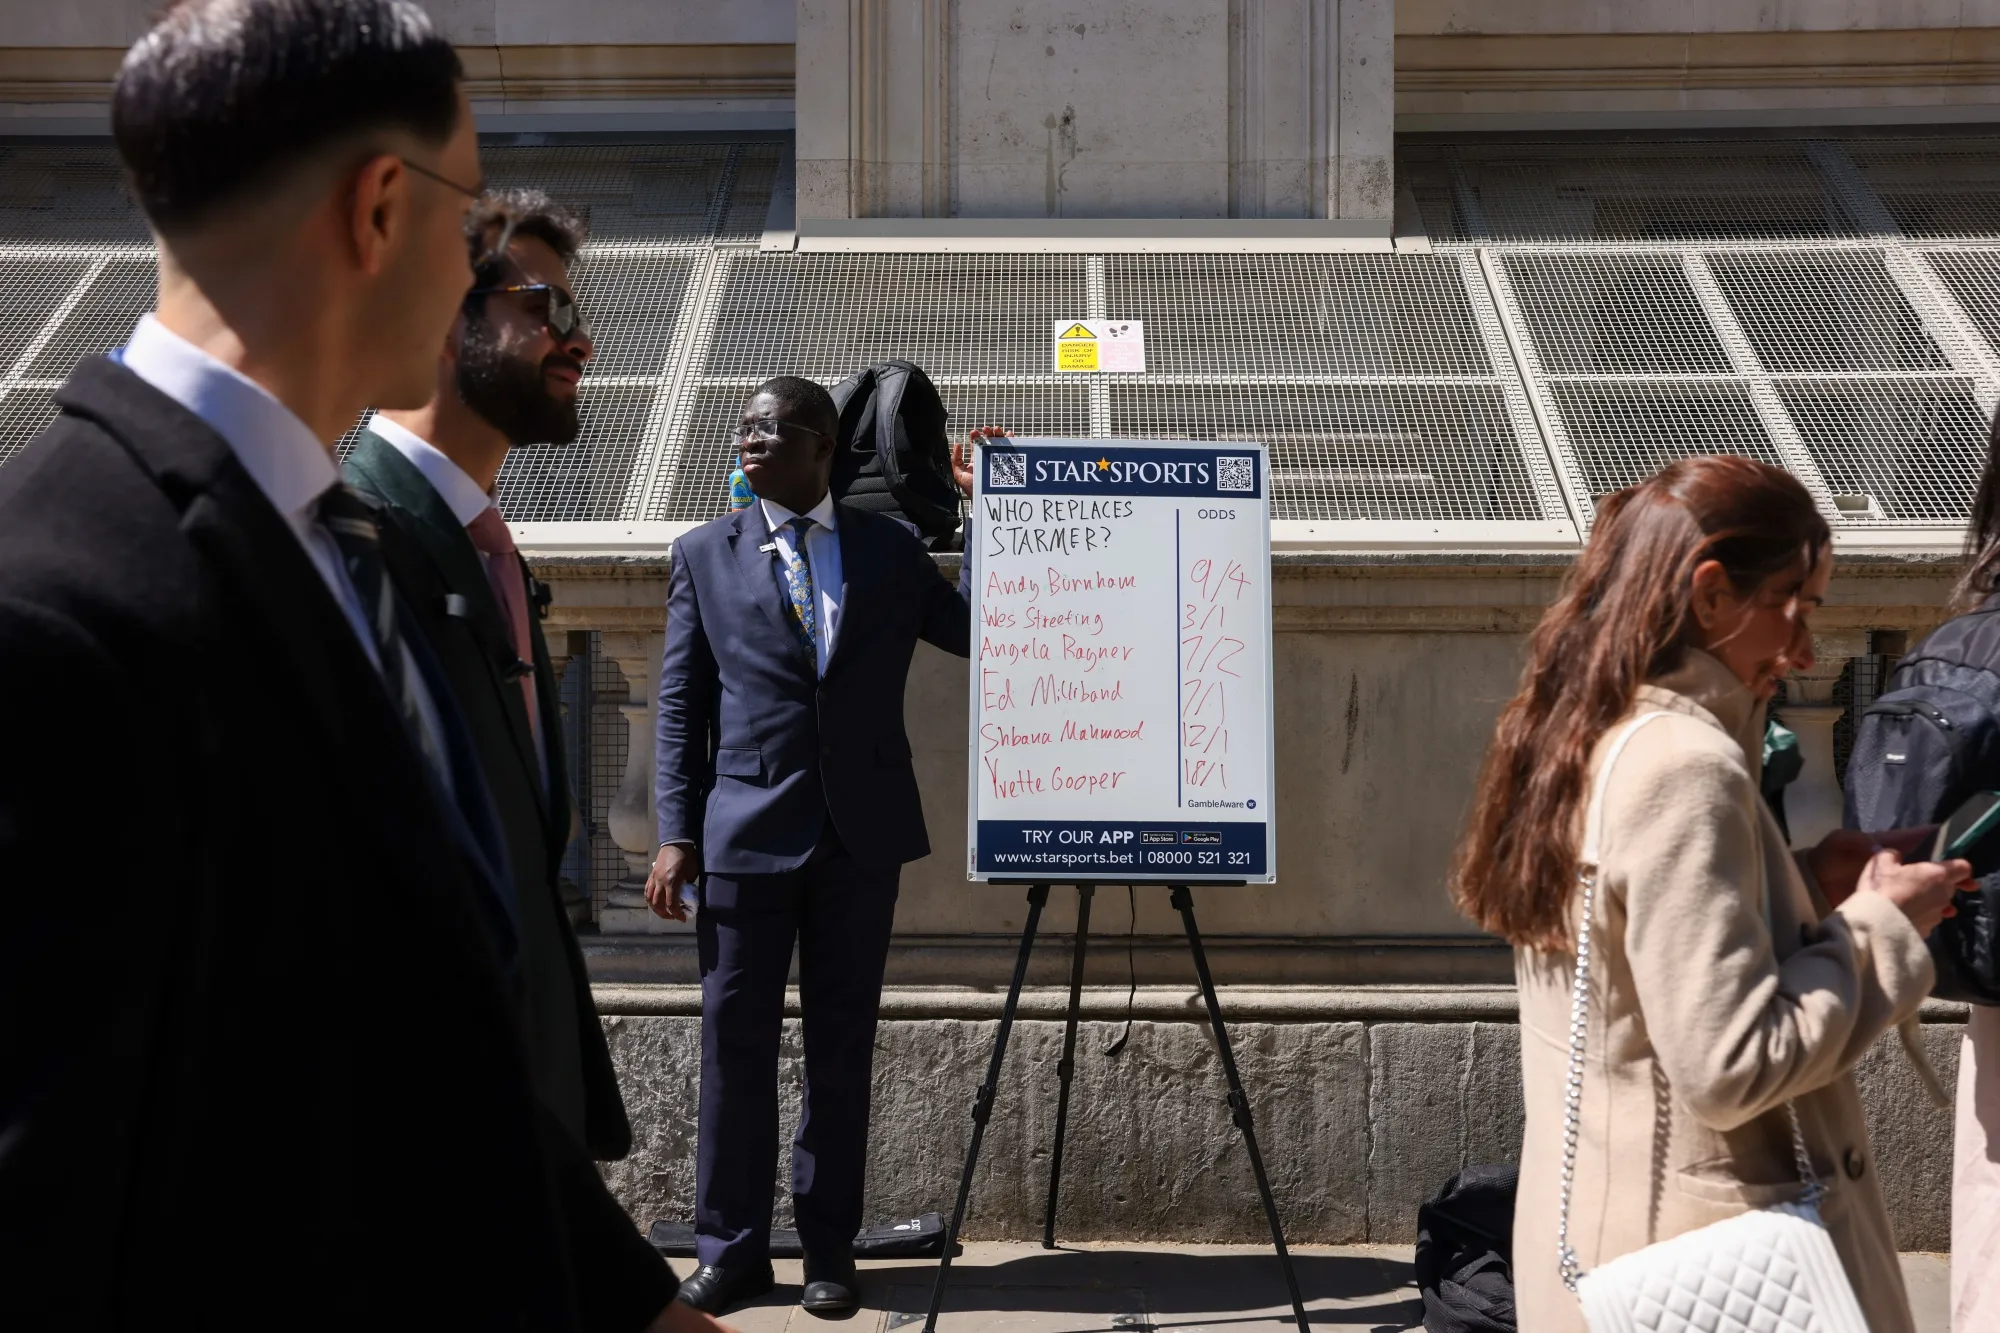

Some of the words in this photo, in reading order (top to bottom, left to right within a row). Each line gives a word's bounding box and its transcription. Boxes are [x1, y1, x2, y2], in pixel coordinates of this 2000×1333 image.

[1035, 459, 1102, 483] STAR
[1110, 461, 1210, 484] SPORTS
[985, 497, 1033, 522] WHO
[1043, 499, 1133, 522] REPLACES
[1198, 509, 1236, 520] ODDS
[989, 526, 1112, 557] STARMER?
[987, 571, 1040, 602] Andy
[1047, 566, 1136, 597] Burnham
[1191, 559, 1251, 602] 9/4
[980, 604, 1016, 628] Wes
[1023, 606, 1104, 635] Streeting
[1182, 604, 1225, 630] 3/1
[980, 636, 1051, 665] Angela
[1182, 635, 1245, 678] 7/2
[983, 668, 1015, 712] Ed
[1182, 679, 1225, 725] 7/1
[1060, 719, 1144, 742] Mahmood
[1182, 721, 1228, 753] 12/1
[983, 755, 1046, 800] Yvette
[1184, 758, 1227, 790] 18/1
[1188, 799, 1244, 809] GambleAware
[1022, 830, 1053, 844] TRY
[1058, 830, 1094, 844] OUR
[1099, 830, 1134, 844] APP
[994, 851, 1133, 867] www.starsports.bet
[1147, 851, 1193, 864] 08000
[1198, 852, 1221, 864] 521
[1227, 852, 1250, 865] 321
